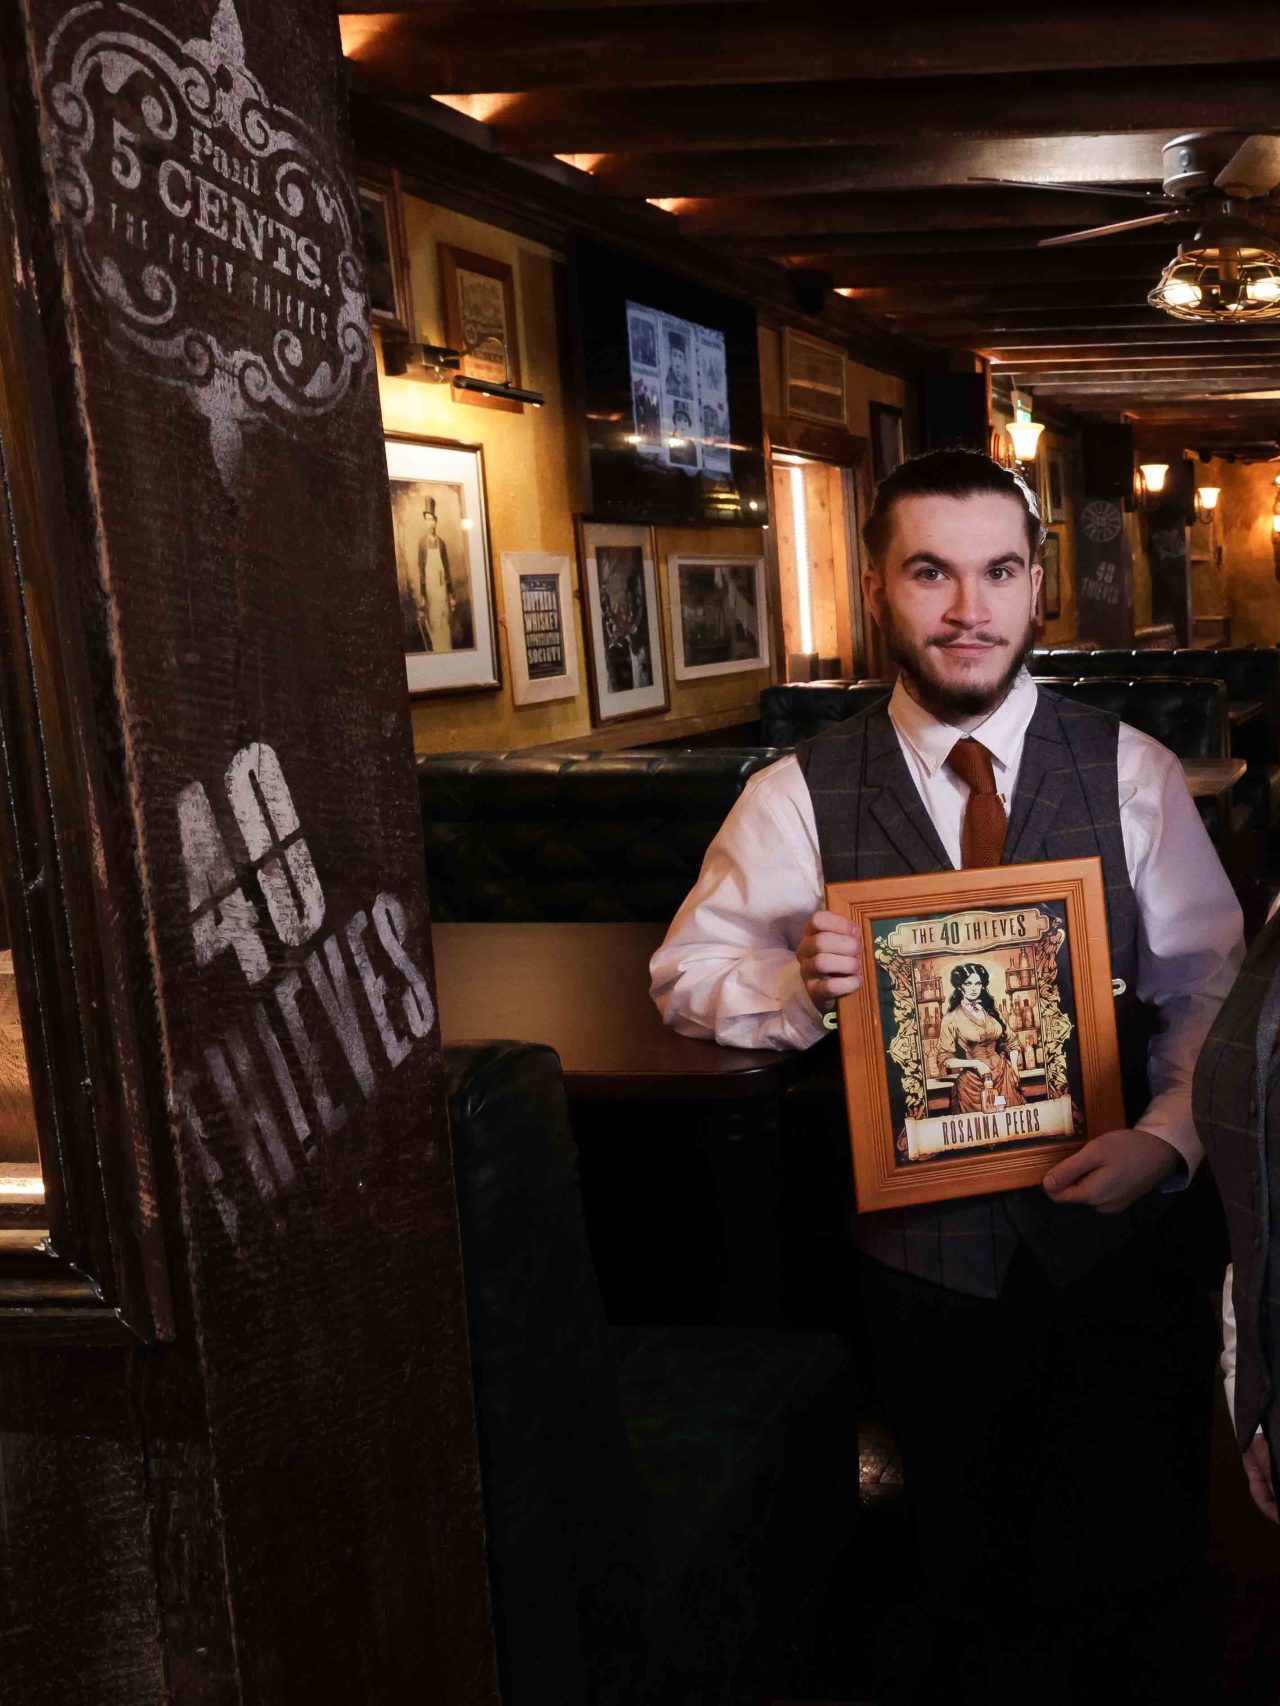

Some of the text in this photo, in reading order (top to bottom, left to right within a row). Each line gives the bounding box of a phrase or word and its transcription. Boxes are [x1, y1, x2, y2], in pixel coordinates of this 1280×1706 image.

[112, 118, 141, 189] 5
[190, 127, 260, 196] Paid
[525, 612, 558, 631] WHISKEY
[528, 647, 560, 664] SOCIETY
[177, 742, 326, 985] 40
[911, 914, 1027, 946] THE 40 THIEVES
[942, 1108, 1041, 1146] ROSANNA PEERS
